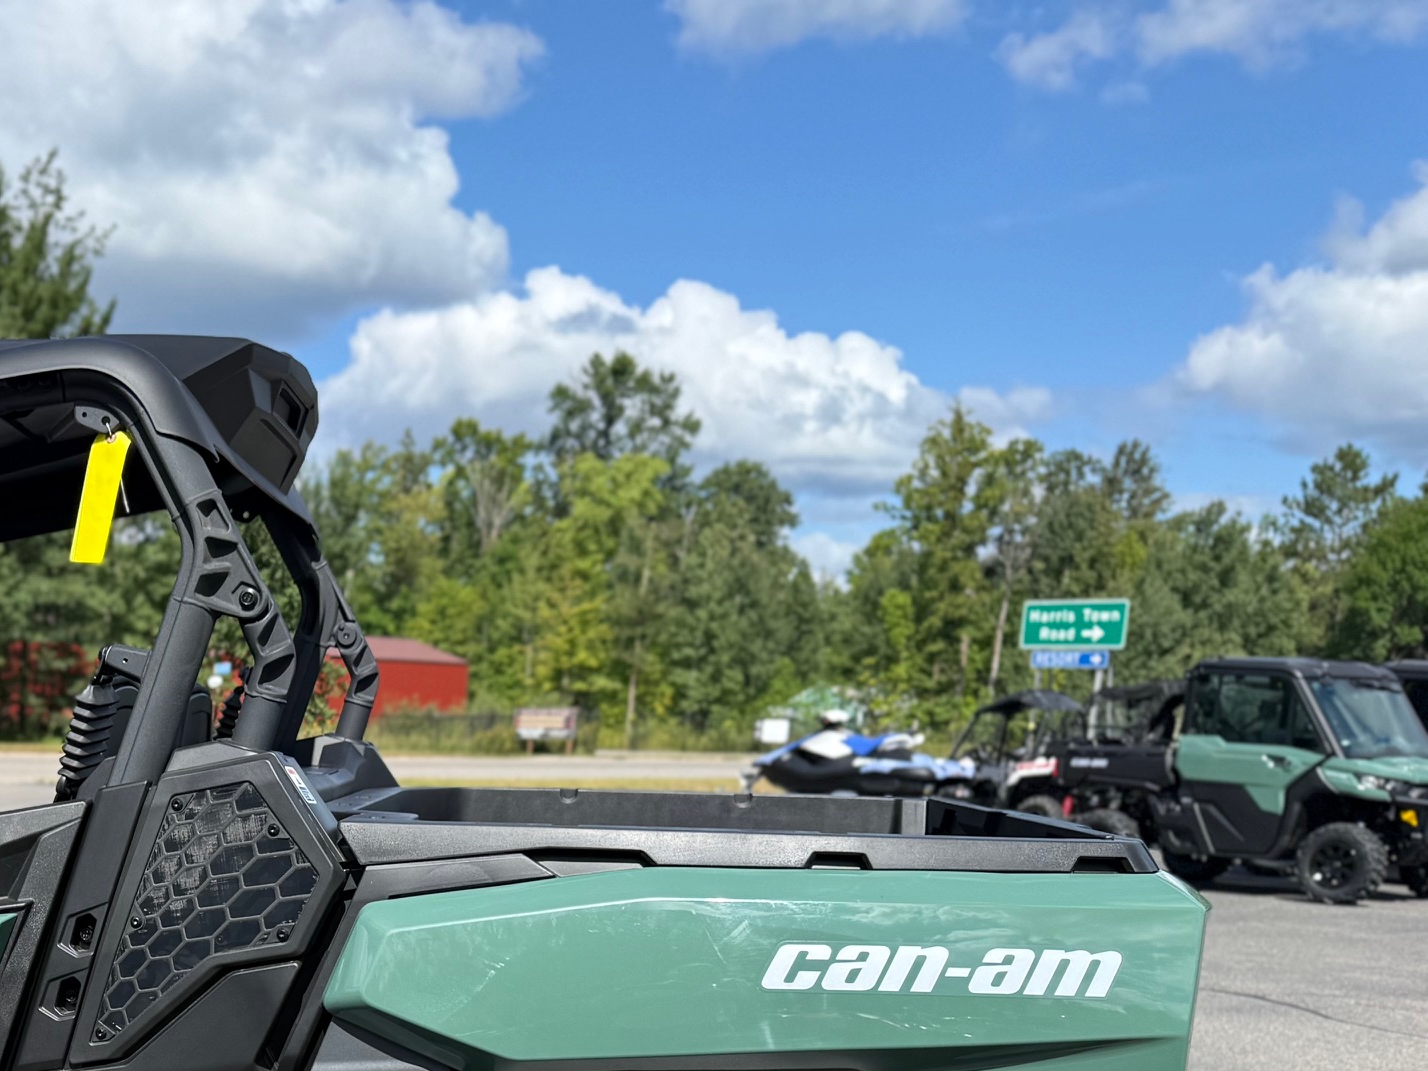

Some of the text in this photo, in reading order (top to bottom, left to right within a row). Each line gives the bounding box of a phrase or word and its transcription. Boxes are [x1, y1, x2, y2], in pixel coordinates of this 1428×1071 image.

[1029, 607, 1121, 623] Harris Town
[1039, 627, 1076, 641] Road
[761, 943, 1123, 998] can-am
